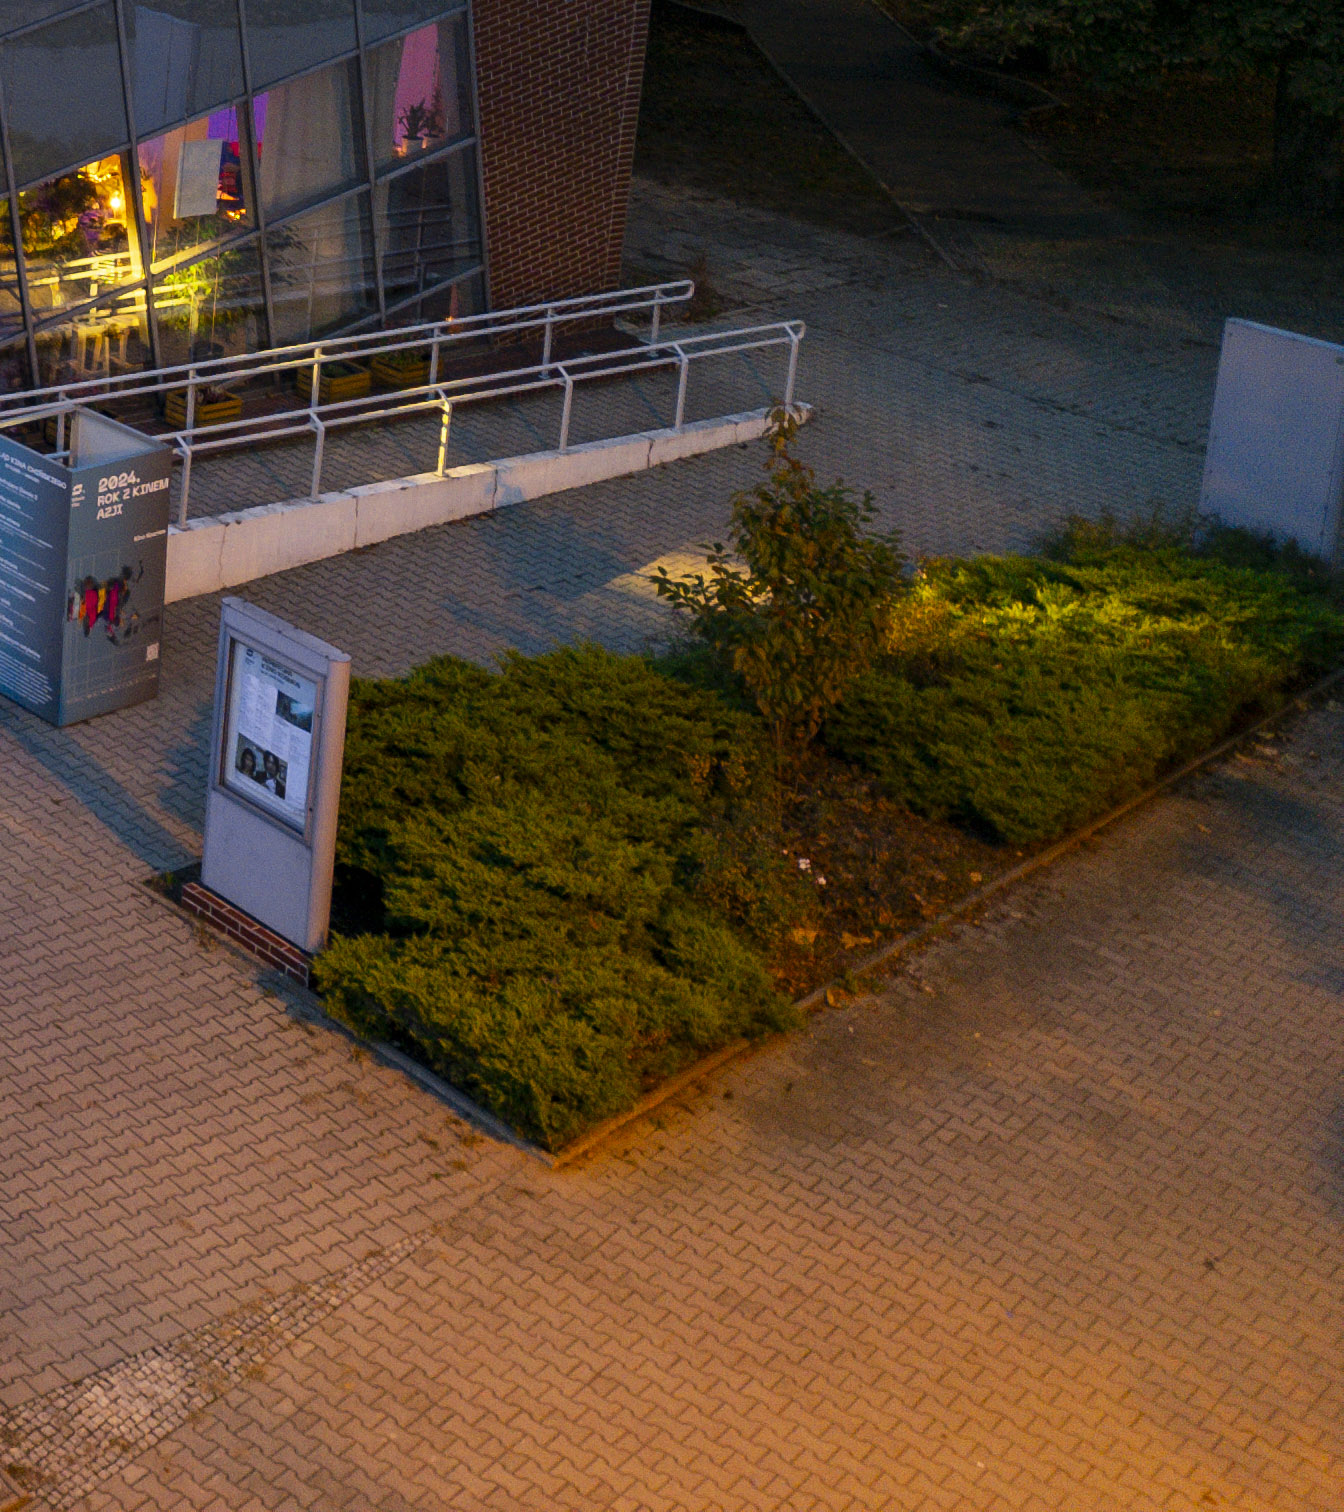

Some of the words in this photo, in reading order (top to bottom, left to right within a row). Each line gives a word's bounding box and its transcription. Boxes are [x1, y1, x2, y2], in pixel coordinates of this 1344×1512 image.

[97, 490, 121, 507] ROK
[132, 477, 170, 498] KINEM
[98, 470, 141, 493] 2024.
